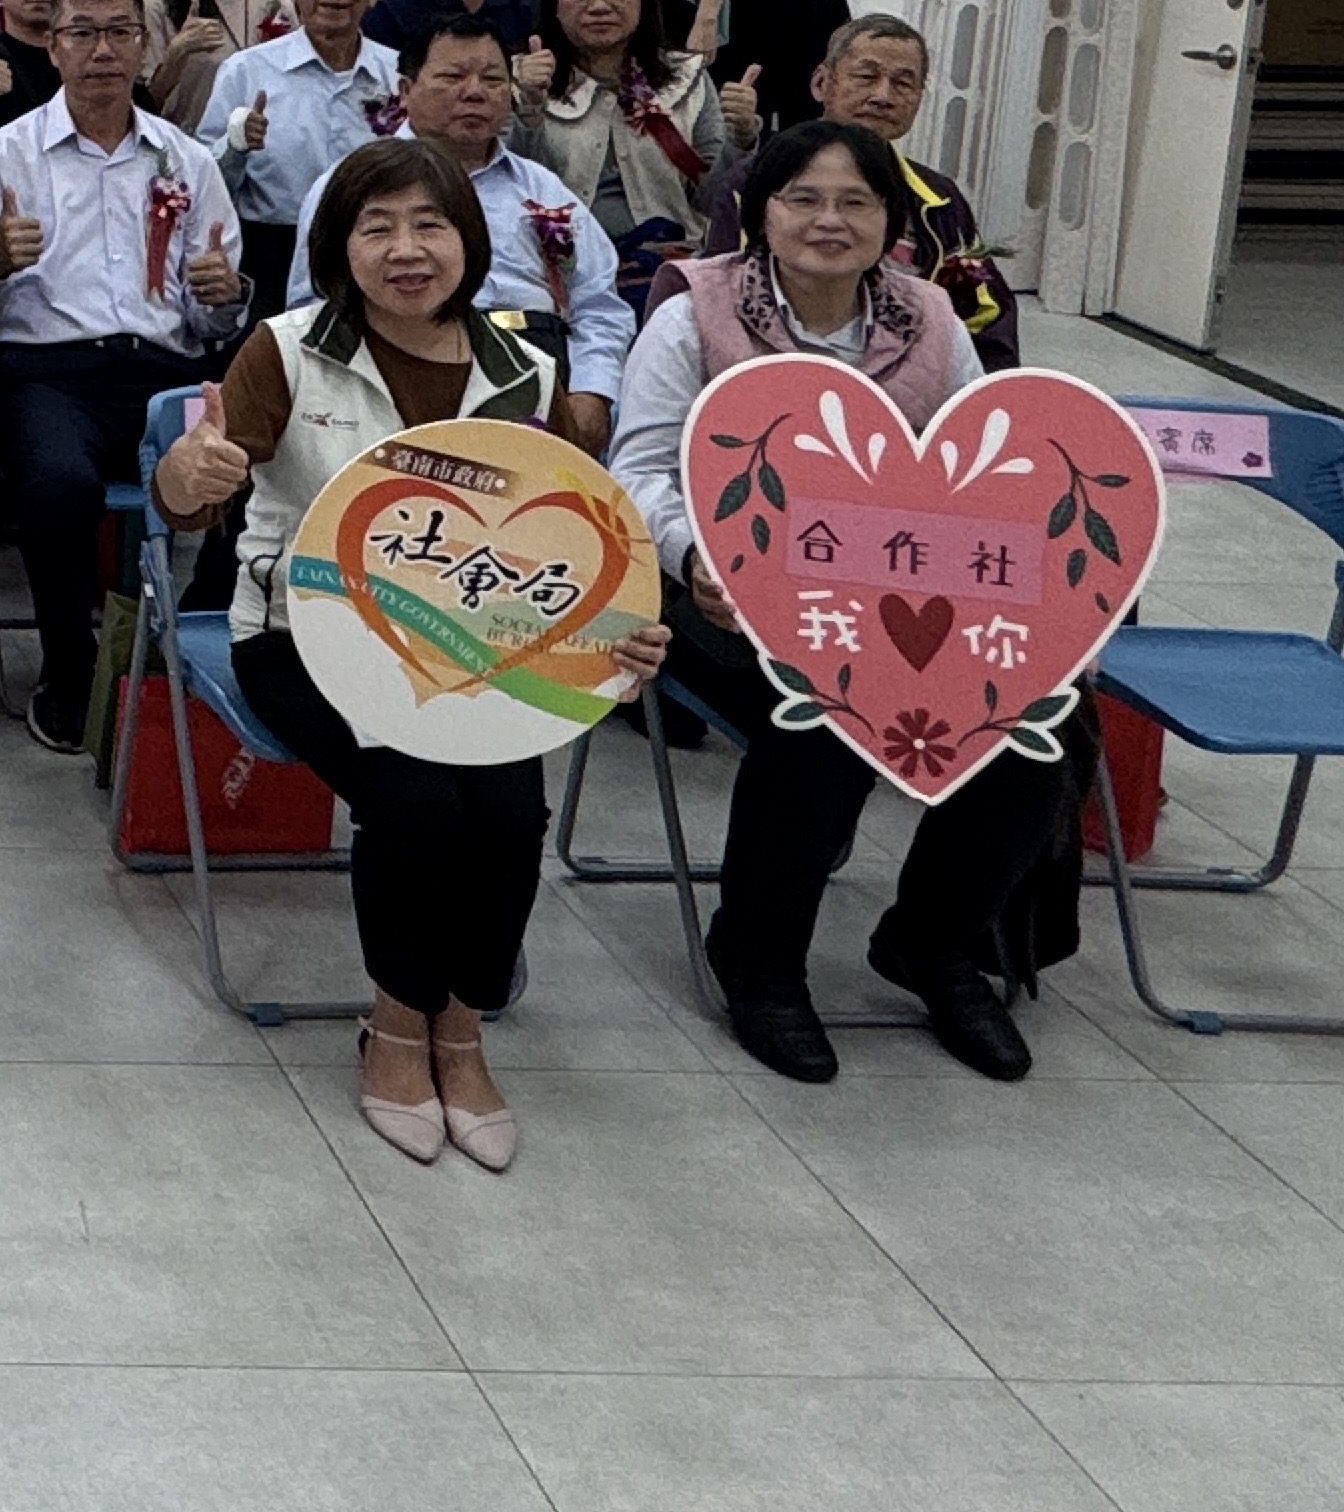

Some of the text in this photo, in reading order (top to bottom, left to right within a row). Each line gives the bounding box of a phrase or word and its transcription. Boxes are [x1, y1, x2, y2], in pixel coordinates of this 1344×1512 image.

[1142, 425, 1216, 456] 賓席
[370, 510, 580, 616] 社會局
[797, 520, 1016, 587] 合作社
[797, 590, 1029, 669] 我 你
